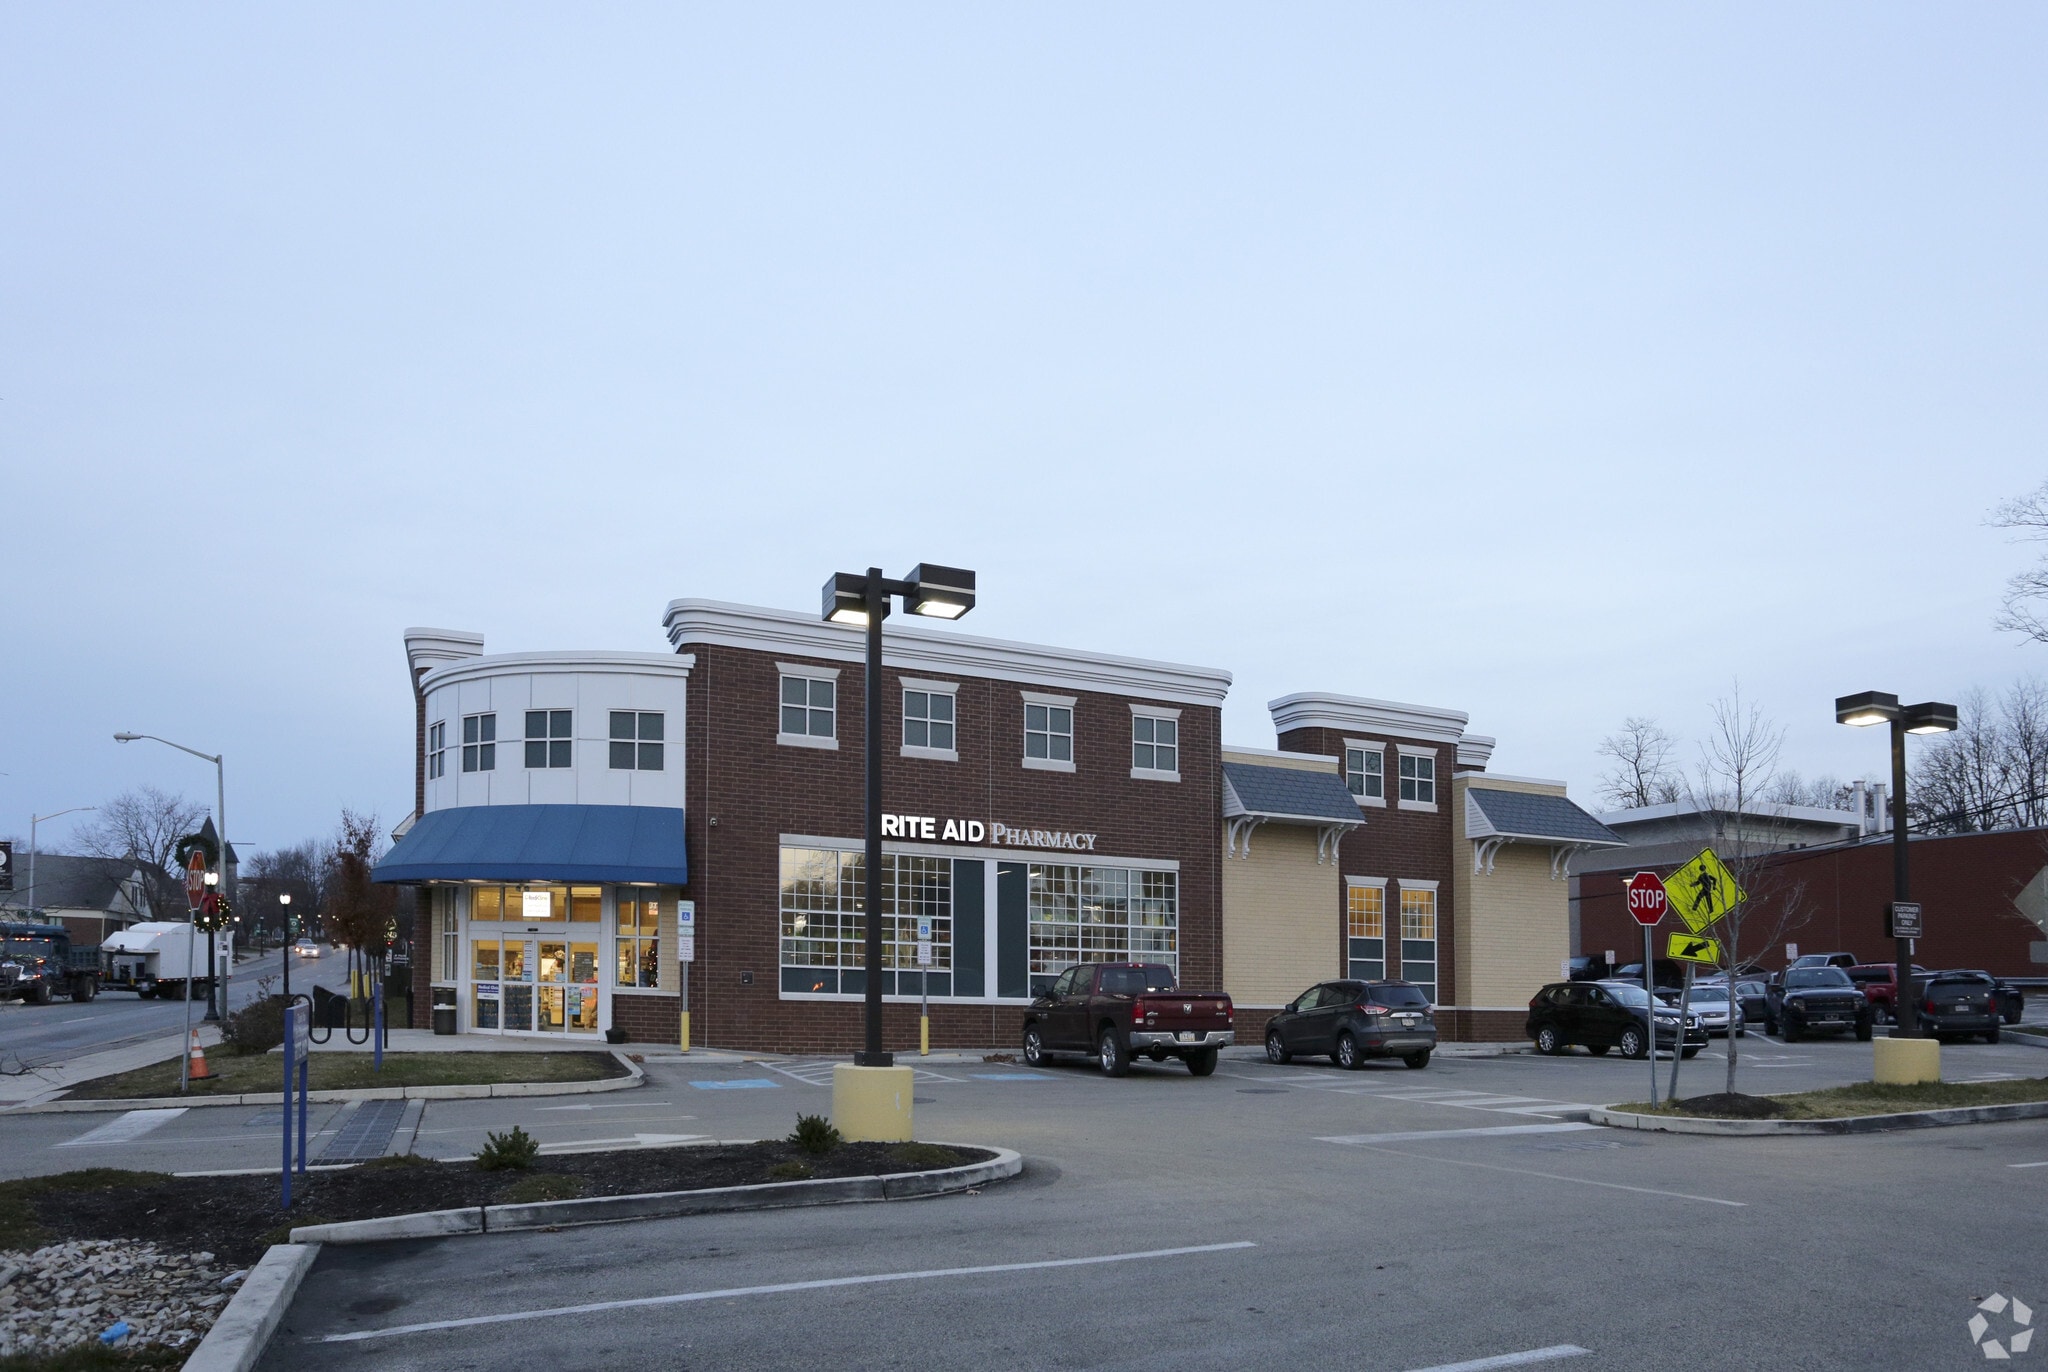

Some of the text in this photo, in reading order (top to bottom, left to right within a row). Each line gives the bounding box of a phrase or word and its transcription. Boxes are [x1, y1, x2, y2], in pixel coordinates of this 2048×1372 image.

[881, 814, 1097, 850] RITE AID PHARMACY
[189, 870, 205, 890] STOP
[1630, 888, 1664, 909] STOP
